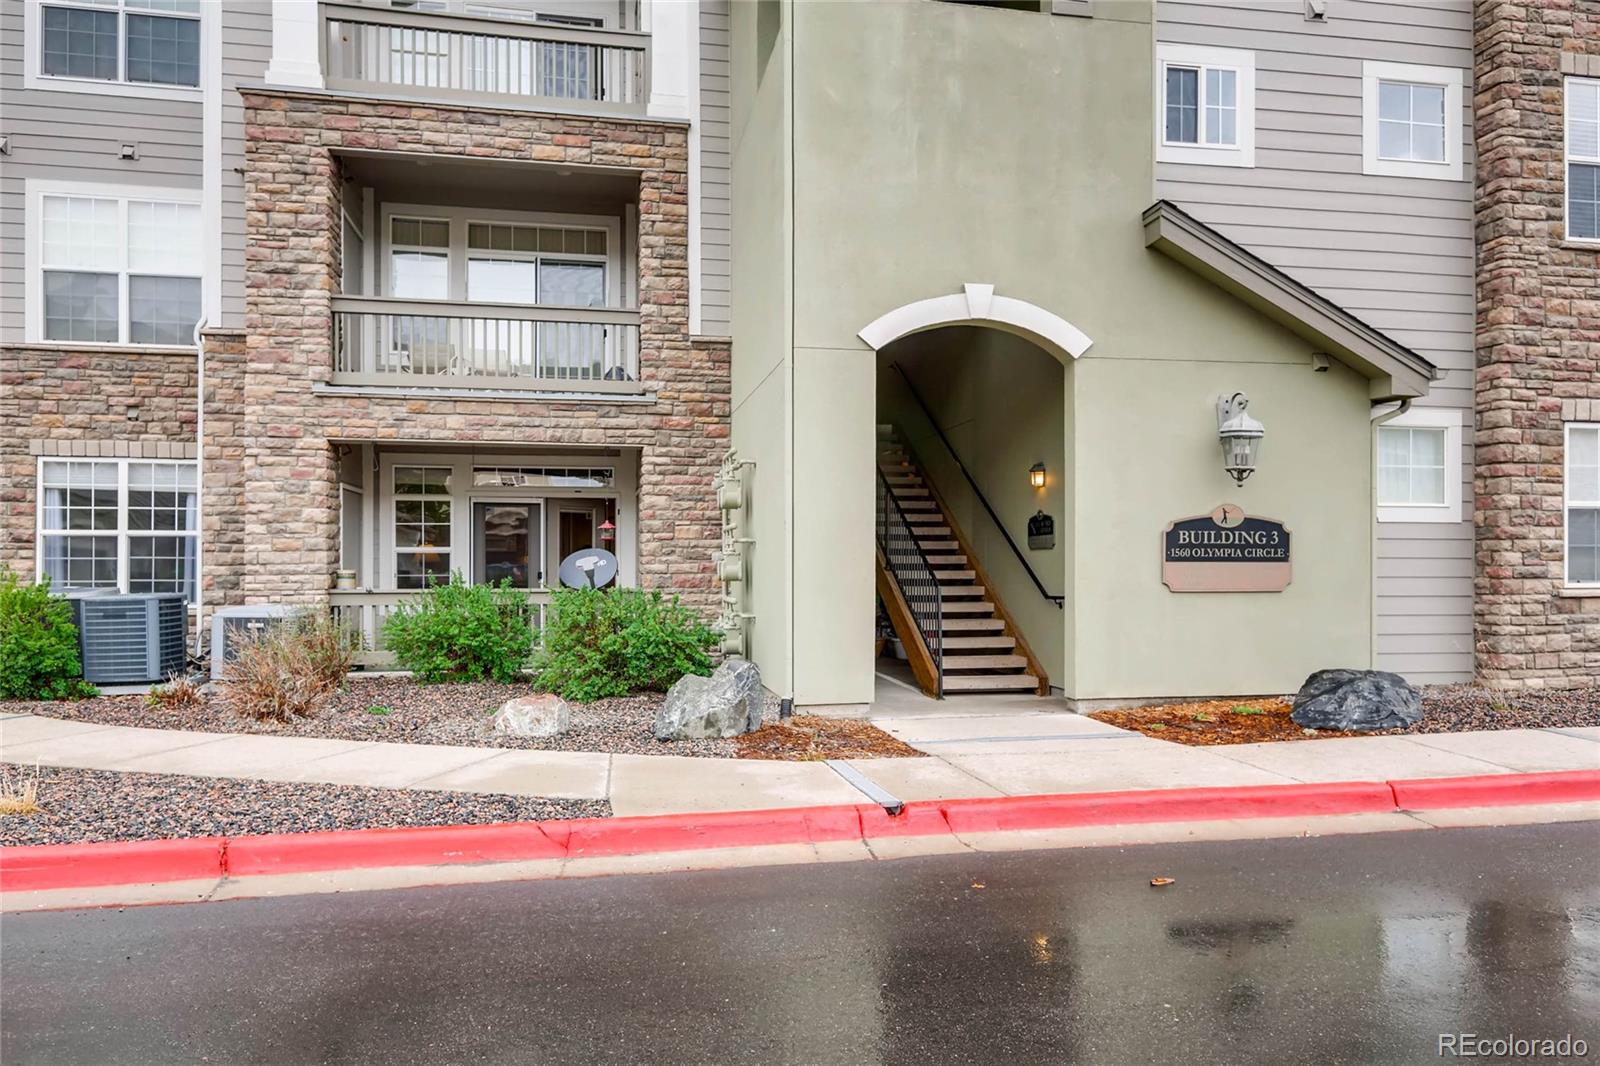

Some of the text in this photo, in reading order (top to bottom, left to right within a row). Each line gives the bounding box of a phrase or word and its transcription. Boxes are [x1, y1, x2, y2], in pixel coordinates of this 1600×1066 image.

[1178, 530, 1279, 545] BUILDING 3
[1171, 548, 1285, 557] 1560 OLYMPIA CIRCLE
